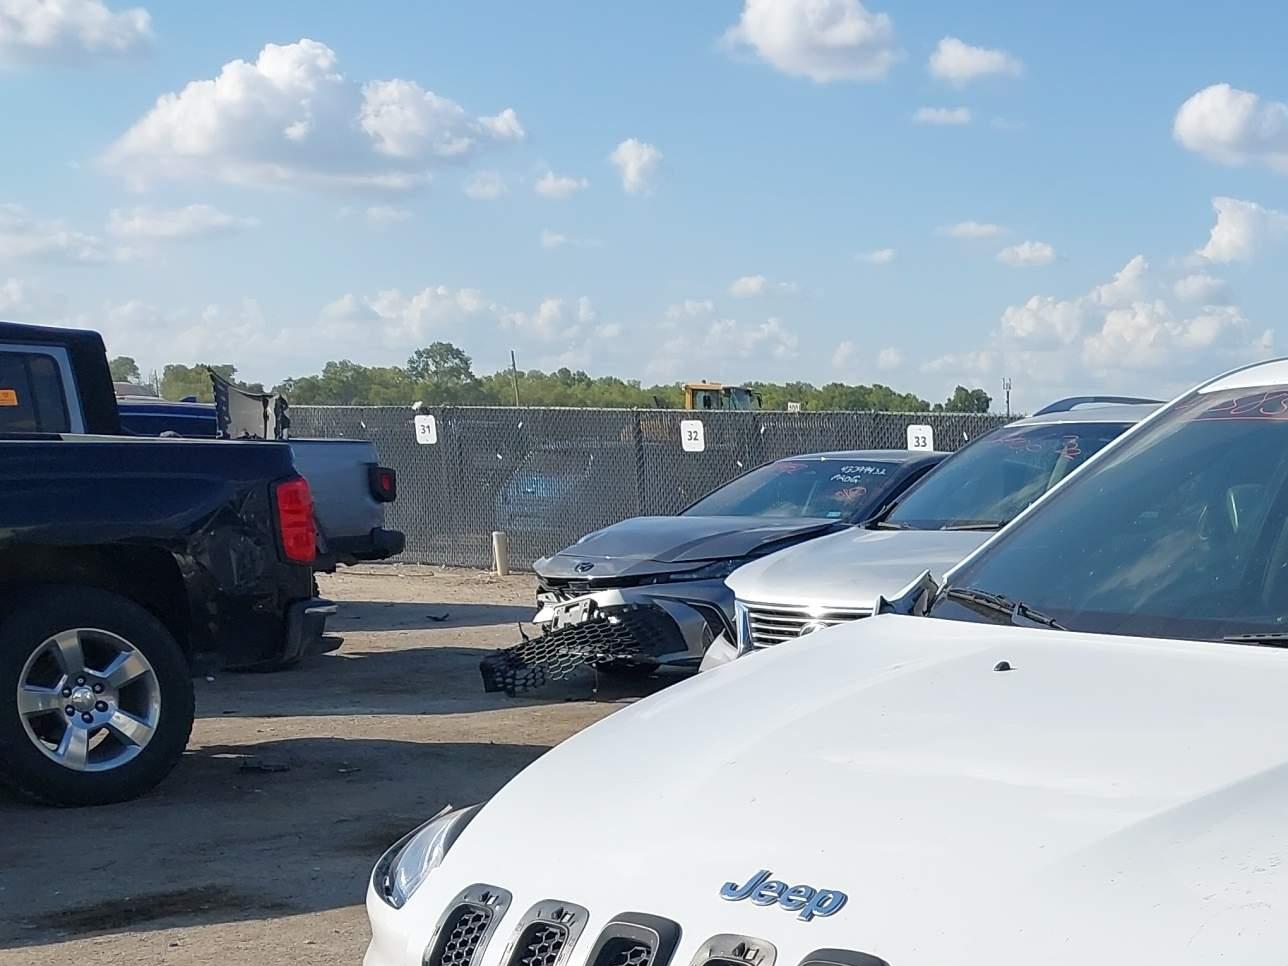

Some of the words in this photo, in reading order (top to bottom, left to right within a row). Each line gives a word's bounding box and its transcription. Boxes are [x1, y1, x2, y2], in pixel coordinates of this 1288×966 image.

[420, 425, 431, 434] 31
[687, 430, 699, 441] 32
[914, 436, 927, 447] 33
[720, 869, 848, 922] Jeep
